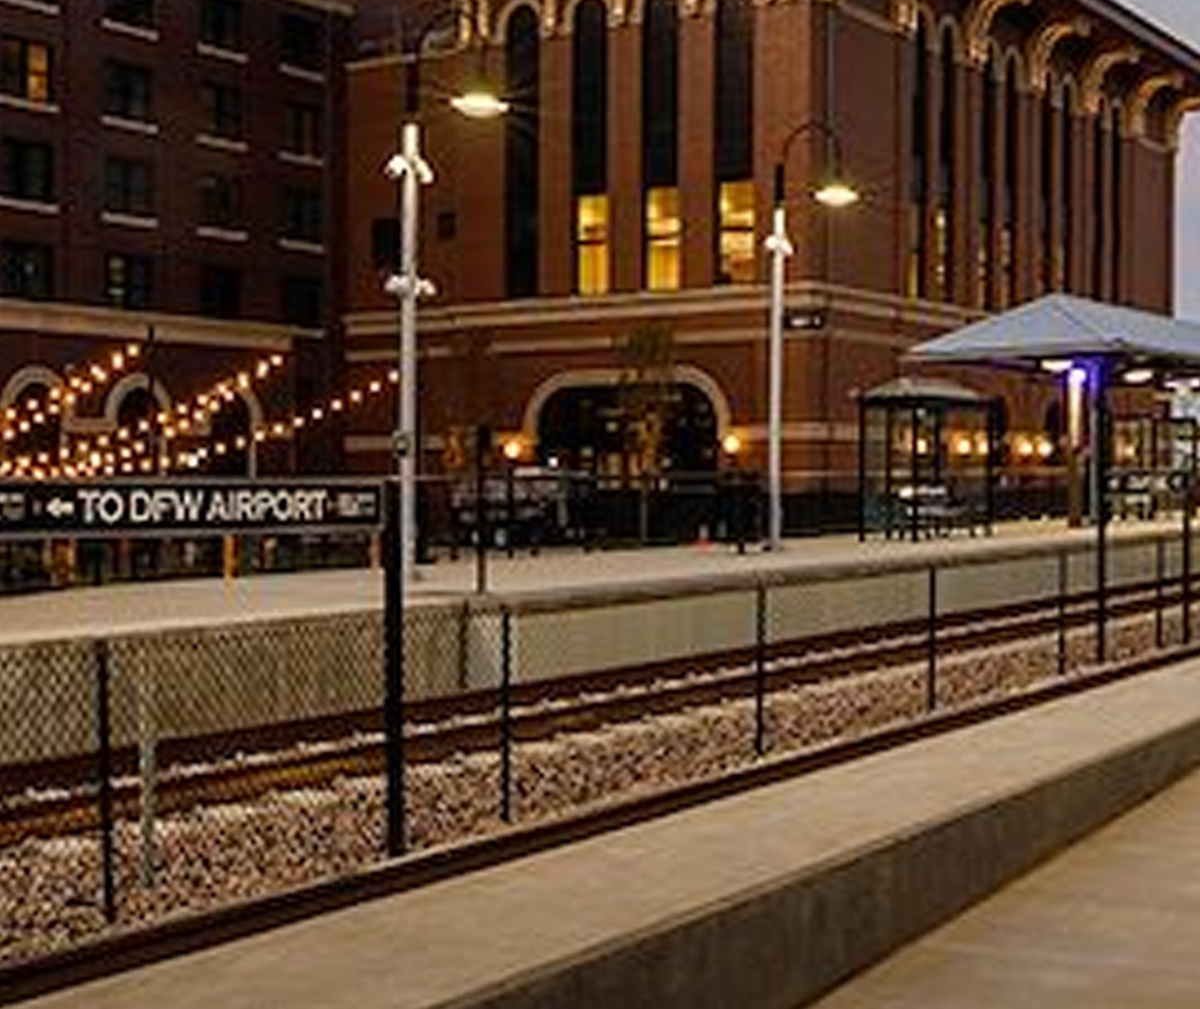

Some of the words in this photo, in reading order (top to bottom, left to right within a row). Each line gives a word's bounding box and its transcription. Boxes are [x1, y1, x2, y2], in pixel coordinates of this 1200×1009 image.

[78, 491, 124, 522] TO
[130, 490, 202, 522] DFW
[205, 490, 328, 522] AIRPORT
